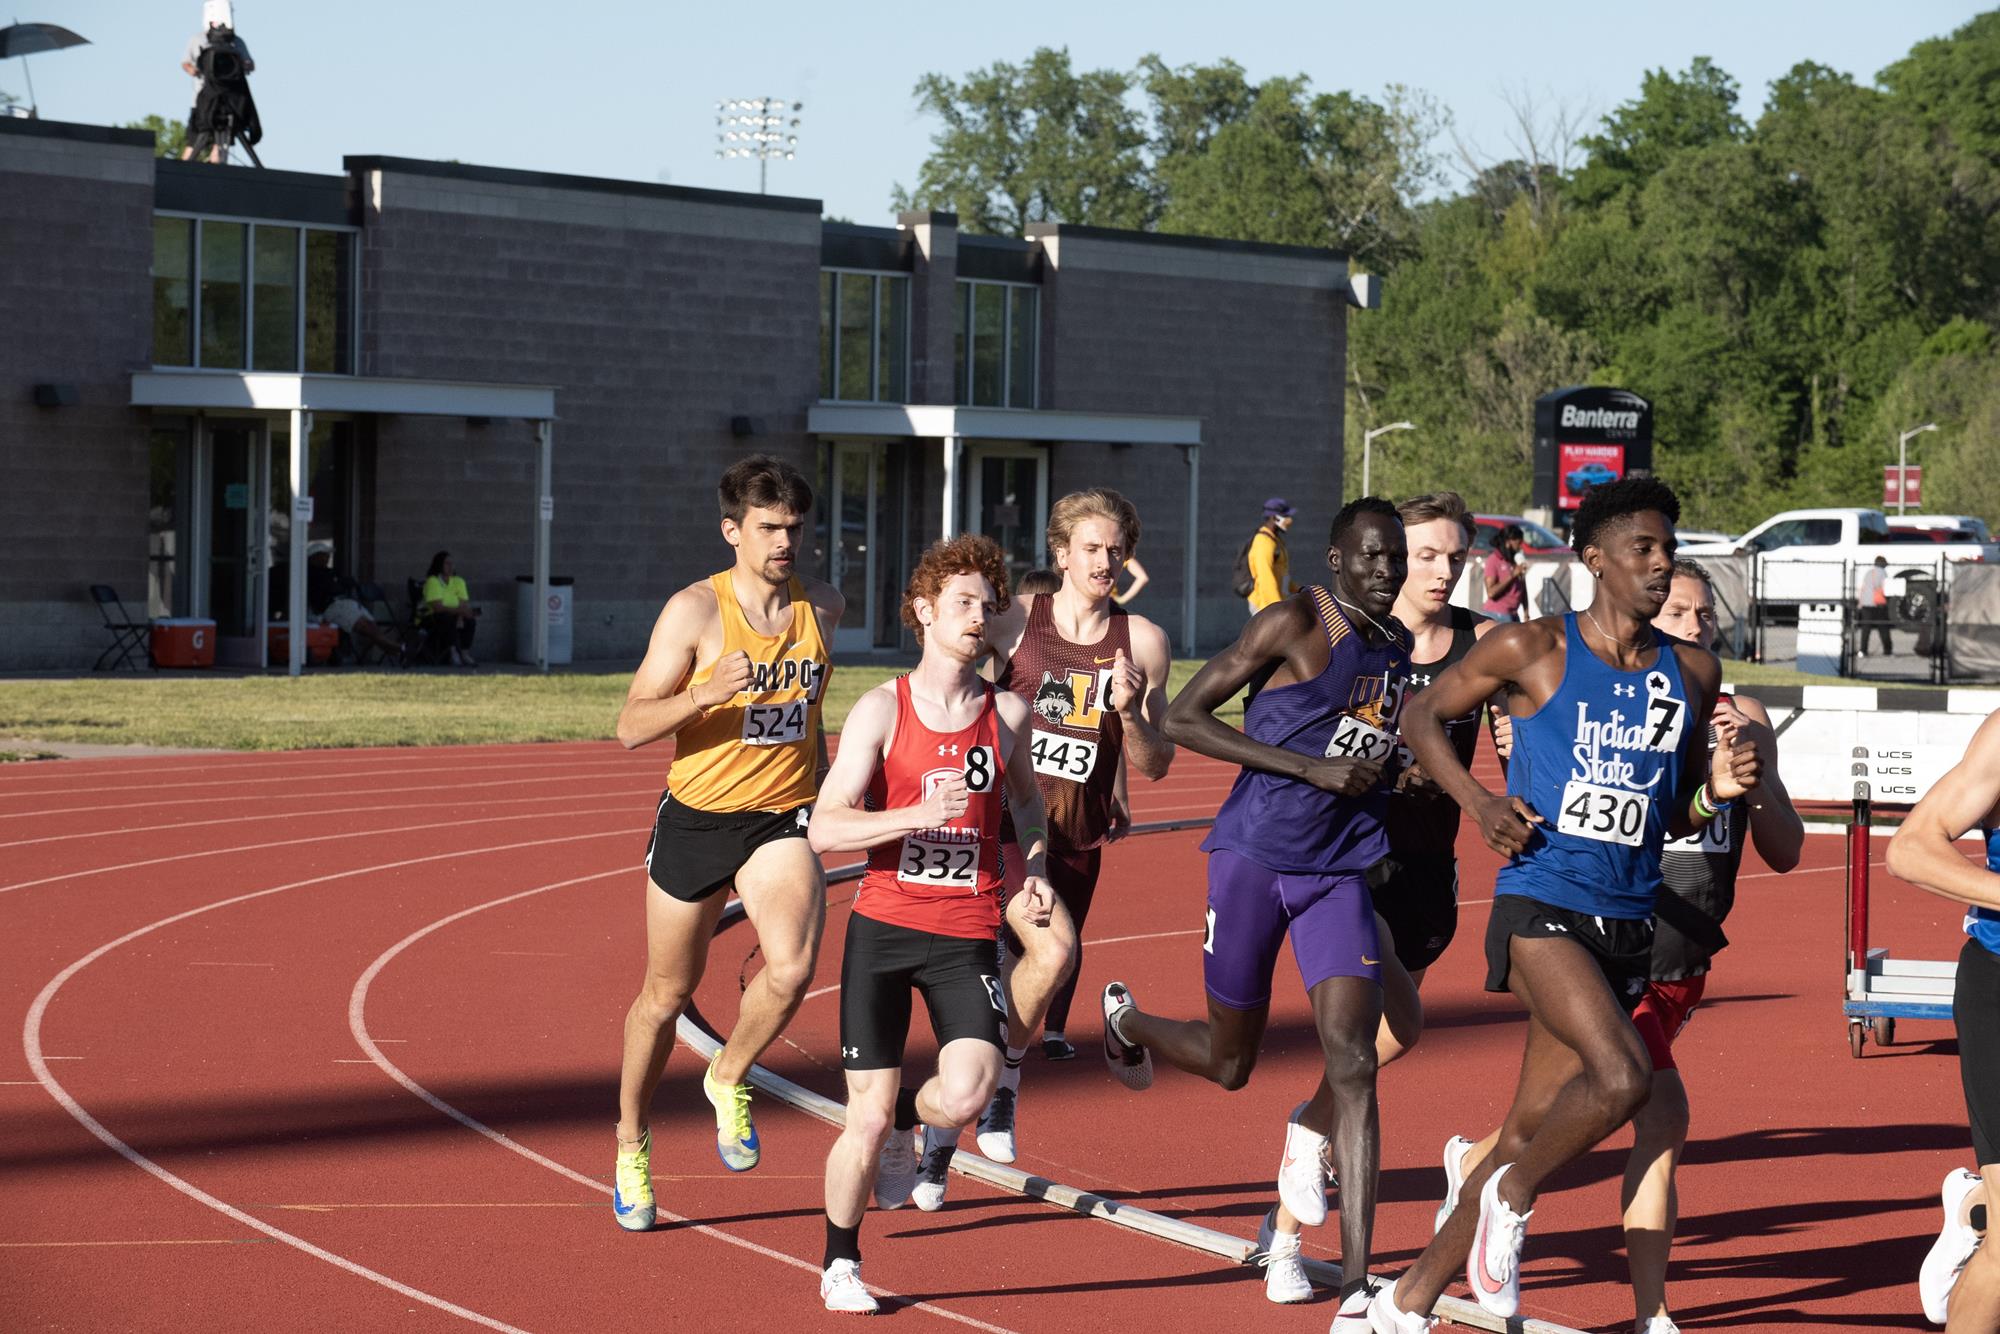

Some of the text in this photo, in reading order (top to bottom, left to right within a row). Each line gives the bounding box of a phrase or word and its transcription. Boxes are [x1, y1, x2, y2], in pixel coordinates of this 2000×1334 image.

[1561, 405, 1639, 429] Banterra
[192, 630, 204, 649] G
[747, 704, 804, 738] 524
[1649, 698, 1680, 747] 7
[1031, 737, 1092, 776] 443
[1333, 727, 1391, 760] 482
[1877, 751, 1913, 759] UCS
[965, 746, 990, 792] 8
[1572, 744, 1664, 790] State
[1877, 767, 1912, 775] UCS
[1881, 786, 1917, 794] UCS
[1565, 791, 1643, 837] 430
[903, 843, 975, 880] 332
